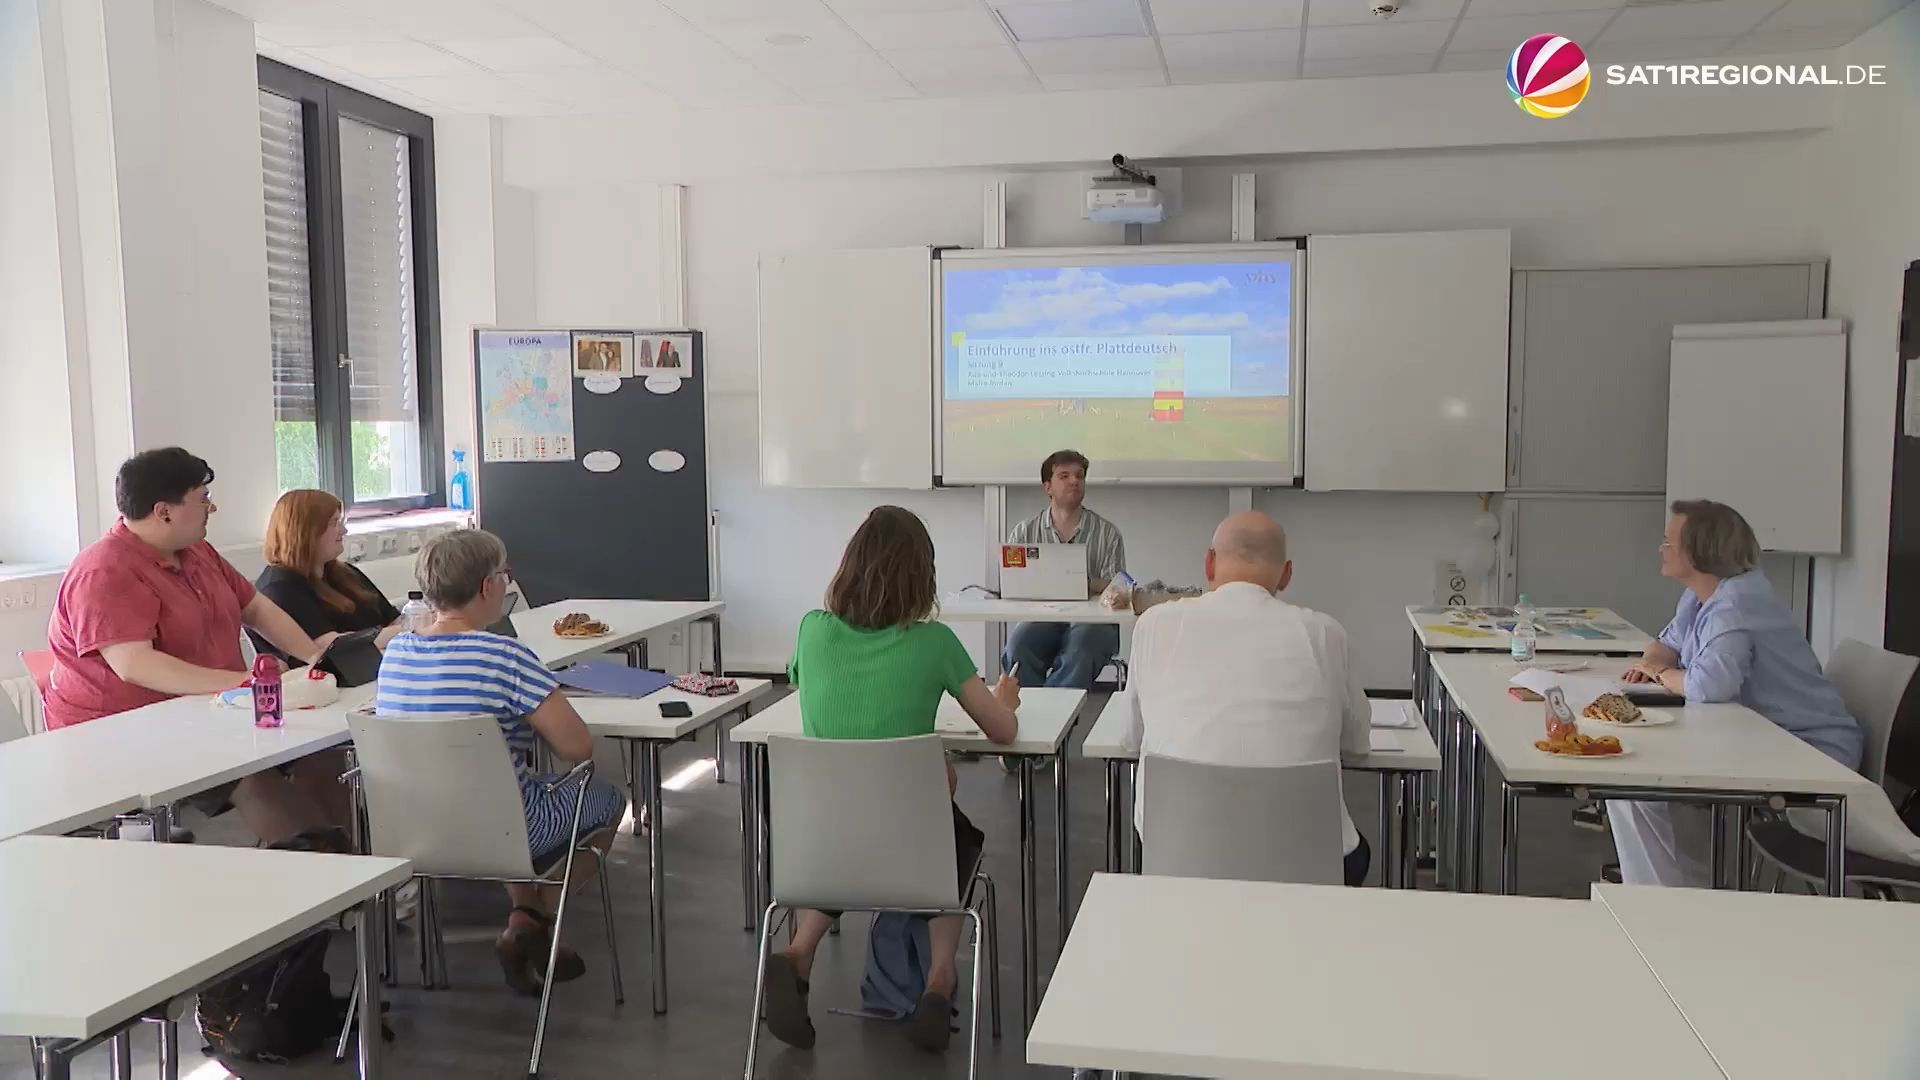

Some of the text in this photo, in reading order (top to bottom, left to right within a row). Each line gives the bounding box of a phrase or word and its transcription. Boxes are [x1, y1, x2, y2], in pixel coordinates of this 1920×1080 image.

[508, 336, 542, 346] EUROPA
[1040, 343, 1057, 356] ins
[1061, 343, 1093, 355] ostfr.
[1097, 342, 1177, 354] Plattdeutsch
